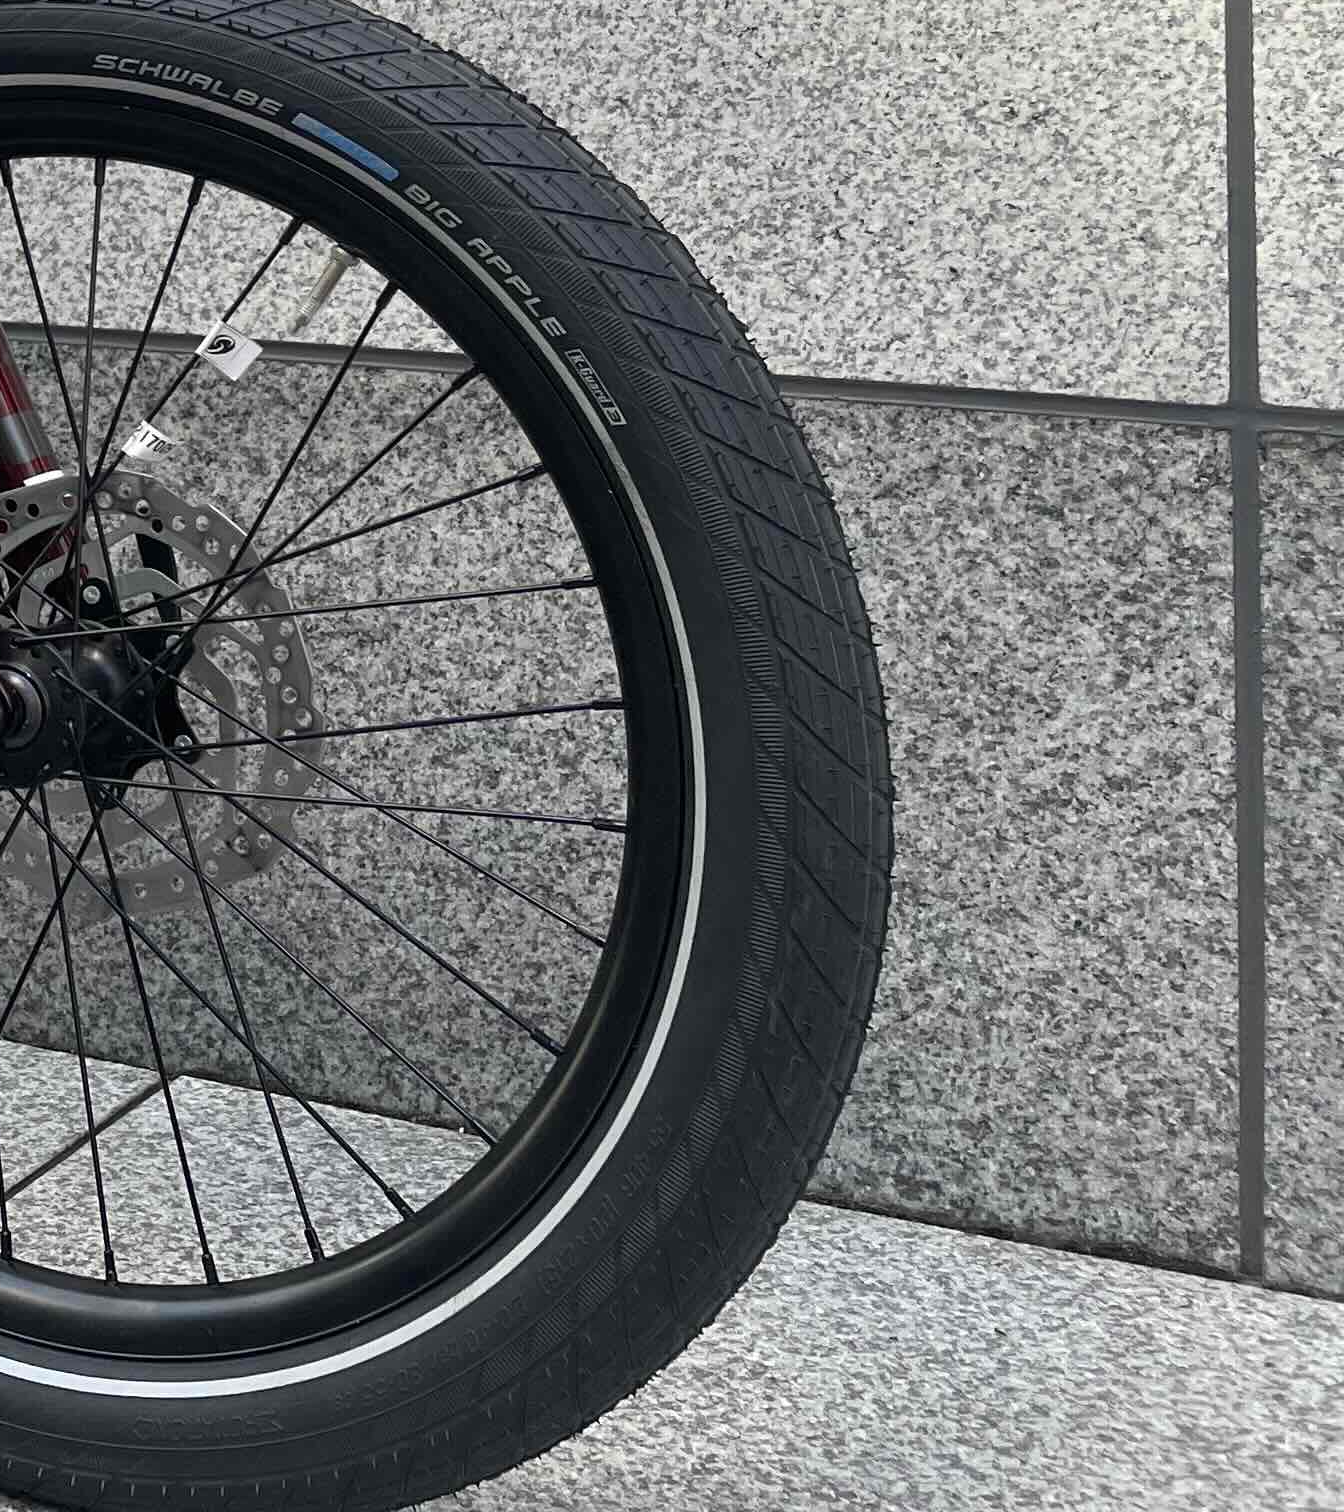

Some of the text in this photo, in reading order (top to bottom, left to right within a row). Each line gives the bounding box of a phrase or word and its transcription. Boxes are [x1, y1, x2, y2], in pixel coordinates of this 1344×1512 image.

[92, 53, 284, 117] SCHWALBE
[403, 183, 463, 229] BIG
[466, 237, 567, 337] APPLE
